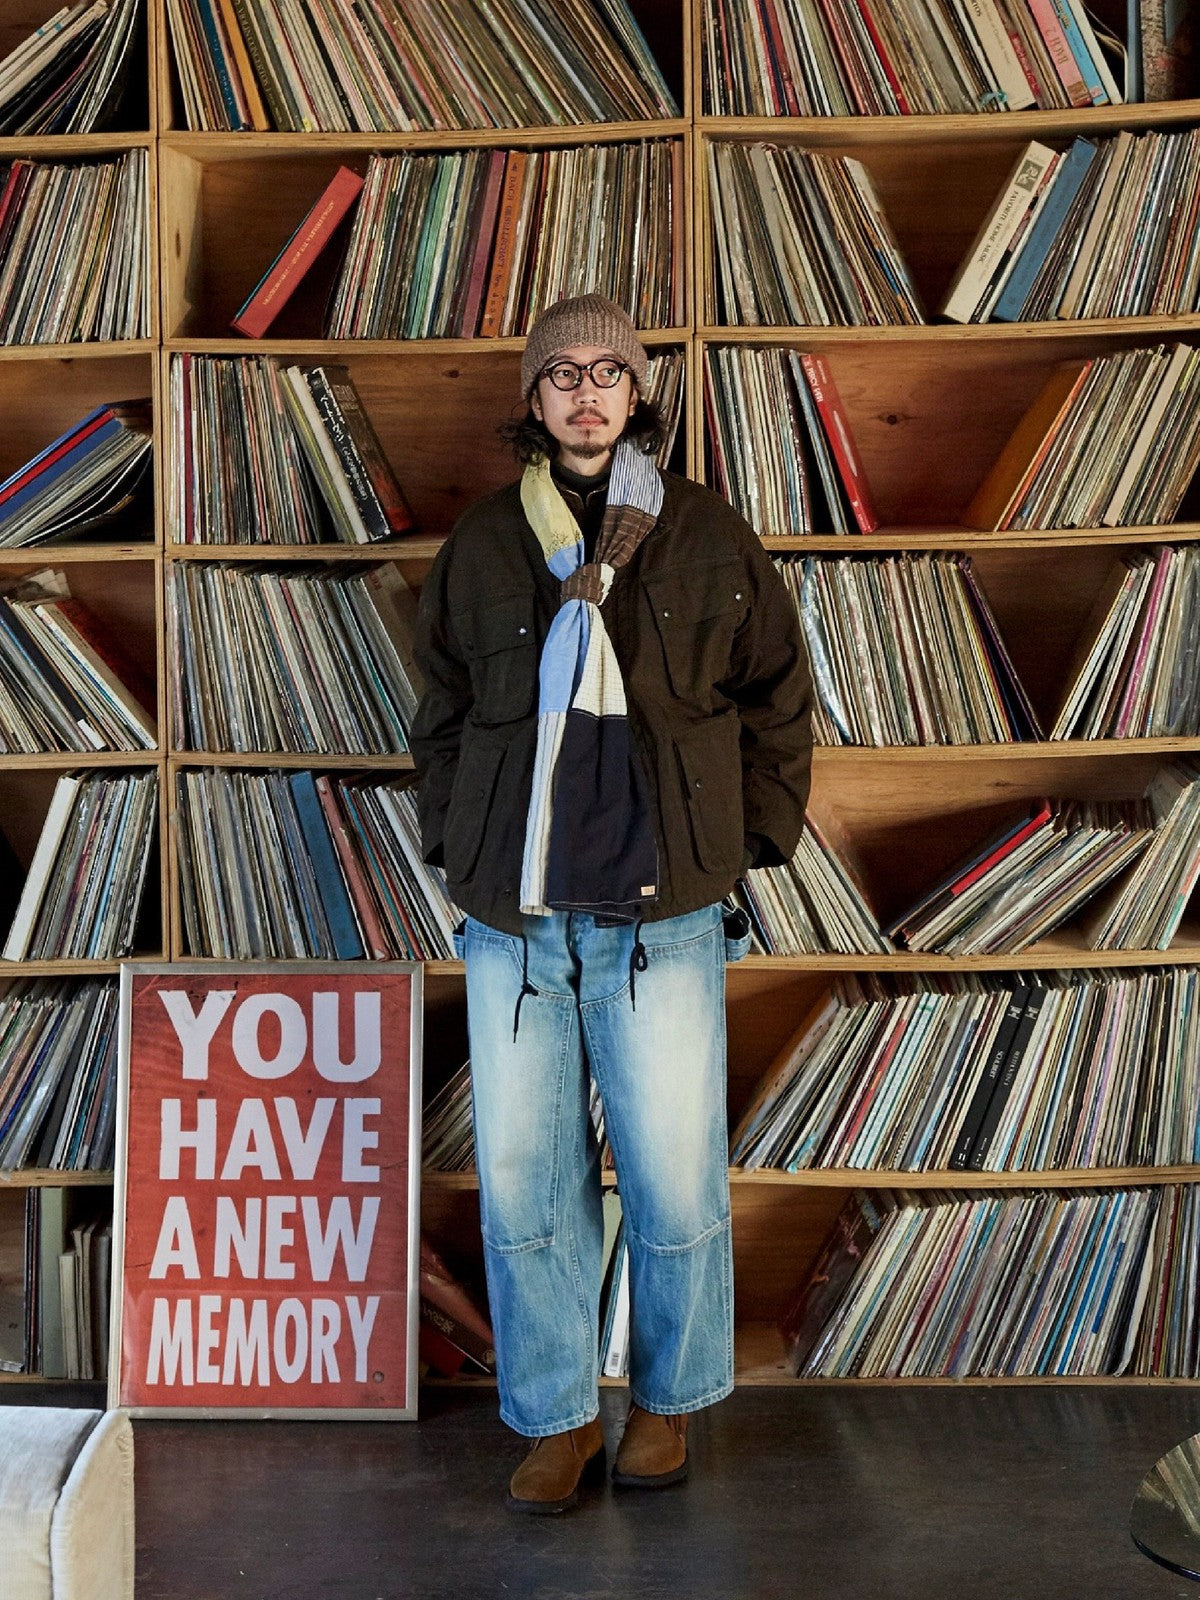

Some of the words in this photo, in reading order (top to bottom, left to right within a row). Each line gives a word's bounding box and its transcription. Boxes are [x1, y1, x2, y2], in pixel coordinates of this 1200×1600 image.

[1044, 26, 1058, 36] 2
[1049, 35, 1069, 65] BACH
[507, 175, 517, 201] BACH
[1001, 190, 1019, 220] FAVORITE
[989, 221, 1003, 241] HOME
[978, 242, 991, 263] MUSIC
[806, 367, 819, 387] PERCY
[157, 990, 382, 1083] YOU
[159, 1097, 381, 1183] HAVE
[148, 1196, 200, 1280] A
[213, 1195, 381, 1282] NEW
[145, 1296, 380, 1387] MEMORY
